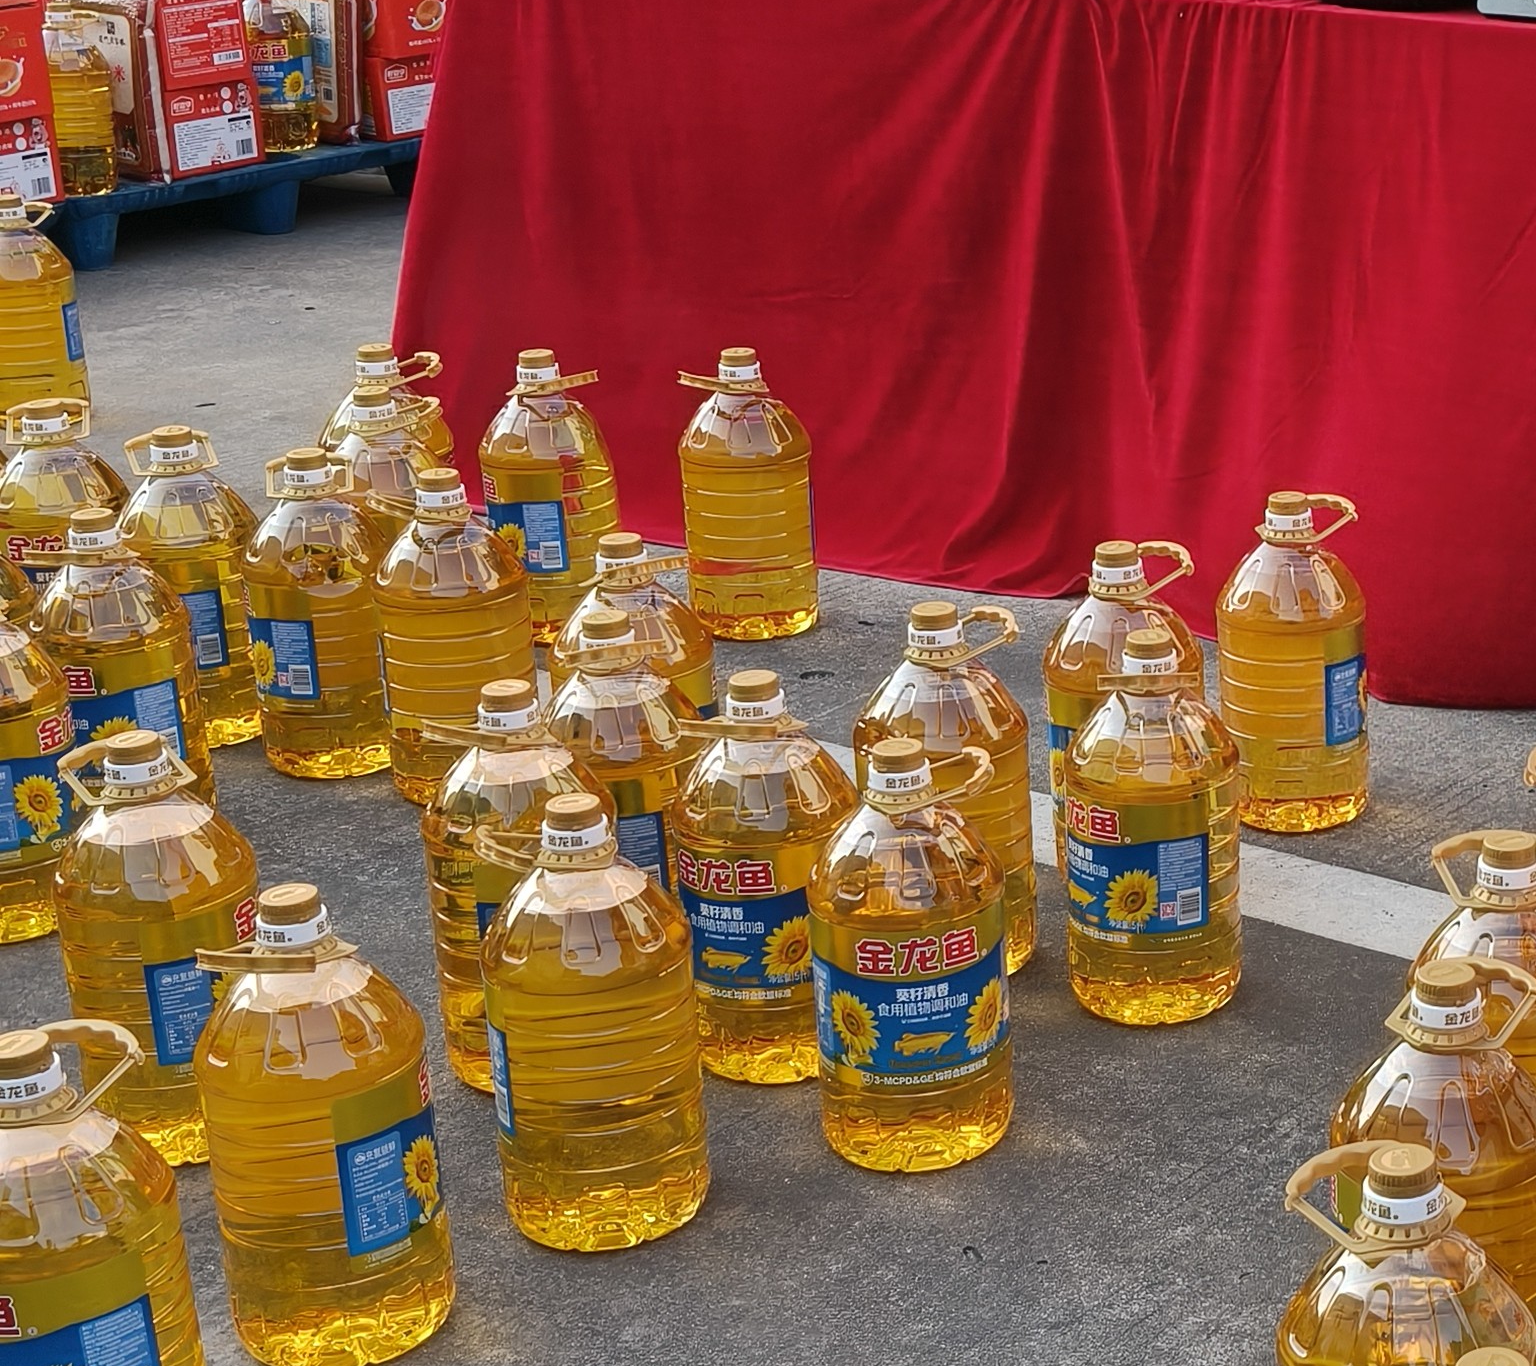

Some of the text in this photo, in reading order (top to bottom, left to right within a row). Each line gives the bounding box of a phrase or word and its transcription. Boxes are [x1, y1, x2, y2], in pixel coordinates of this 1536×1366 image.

[252, 44, 287, 60] 龙鱼
[162, 448, 192, 460] 金龙鱼
[730, 706, 765, 718] 金龙鱼
[885, 775, 921, 789] 金龙鱼
[1066, 797, 1120, 842] 龙鱼
[546, 834, 584, 847] 金龙鱼
[677, 848, 776, 895] 金龙鱼
[856, 925, 980, 977] 金龙鱼
[896, 982, 950, 1001] 葵籽清香
[877, 992, 969, 1018] 食用植物调和油
